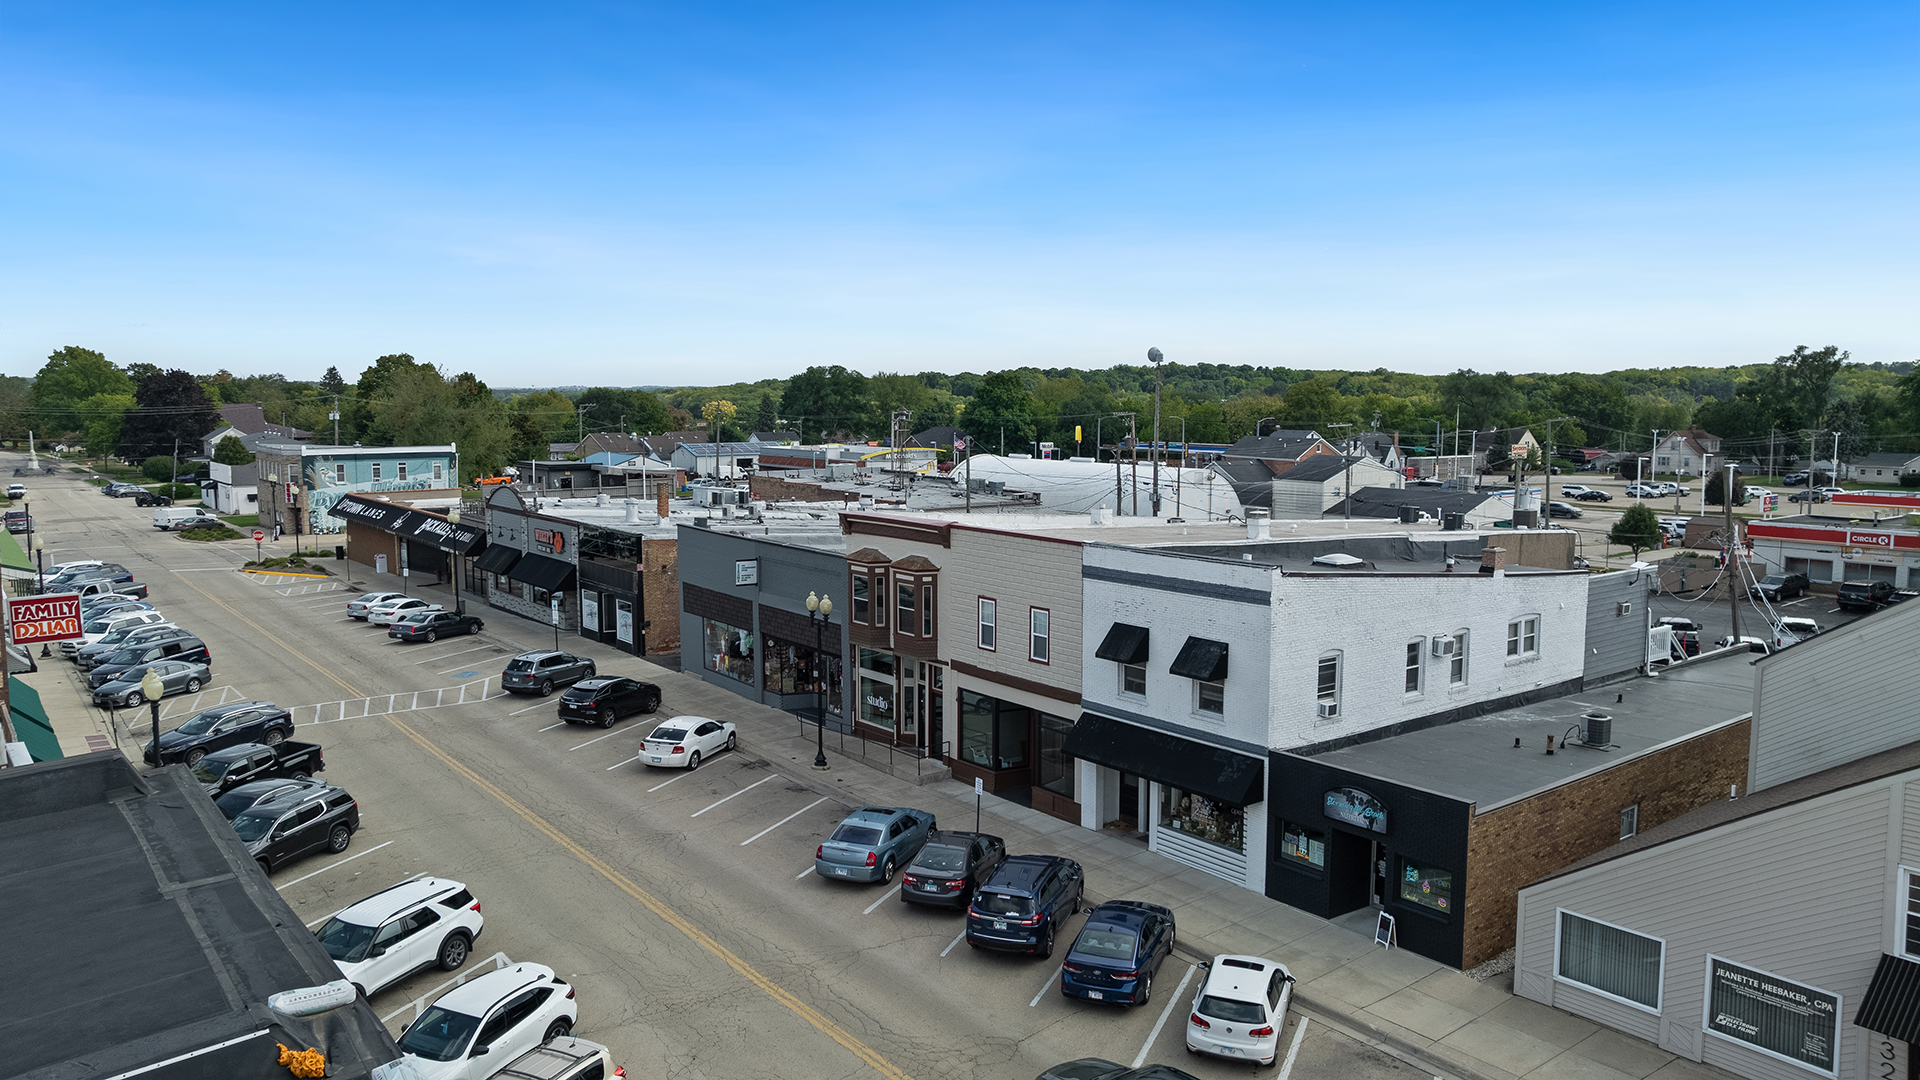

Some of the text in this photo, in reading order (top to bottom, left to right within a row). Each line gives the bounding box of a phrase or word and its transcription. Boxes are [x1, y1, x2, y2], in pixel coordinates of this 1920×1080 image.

[336, 498, 386, 520] UPTOWN LANES
[1852, 535, 1888, 545] CIRCLE K
[12, 600, 78, 622] FAMILY
[14, 618, 78, 639] DOLLAR
[866, 694, 888, 710] studio
[1716, 968, 1834, 1013] JEANETTE HEESAKER, CPA
[1725, 1016, 1760, 1032] ELECTRONIC
[1738, 1025, 1756, 1035] FILING
